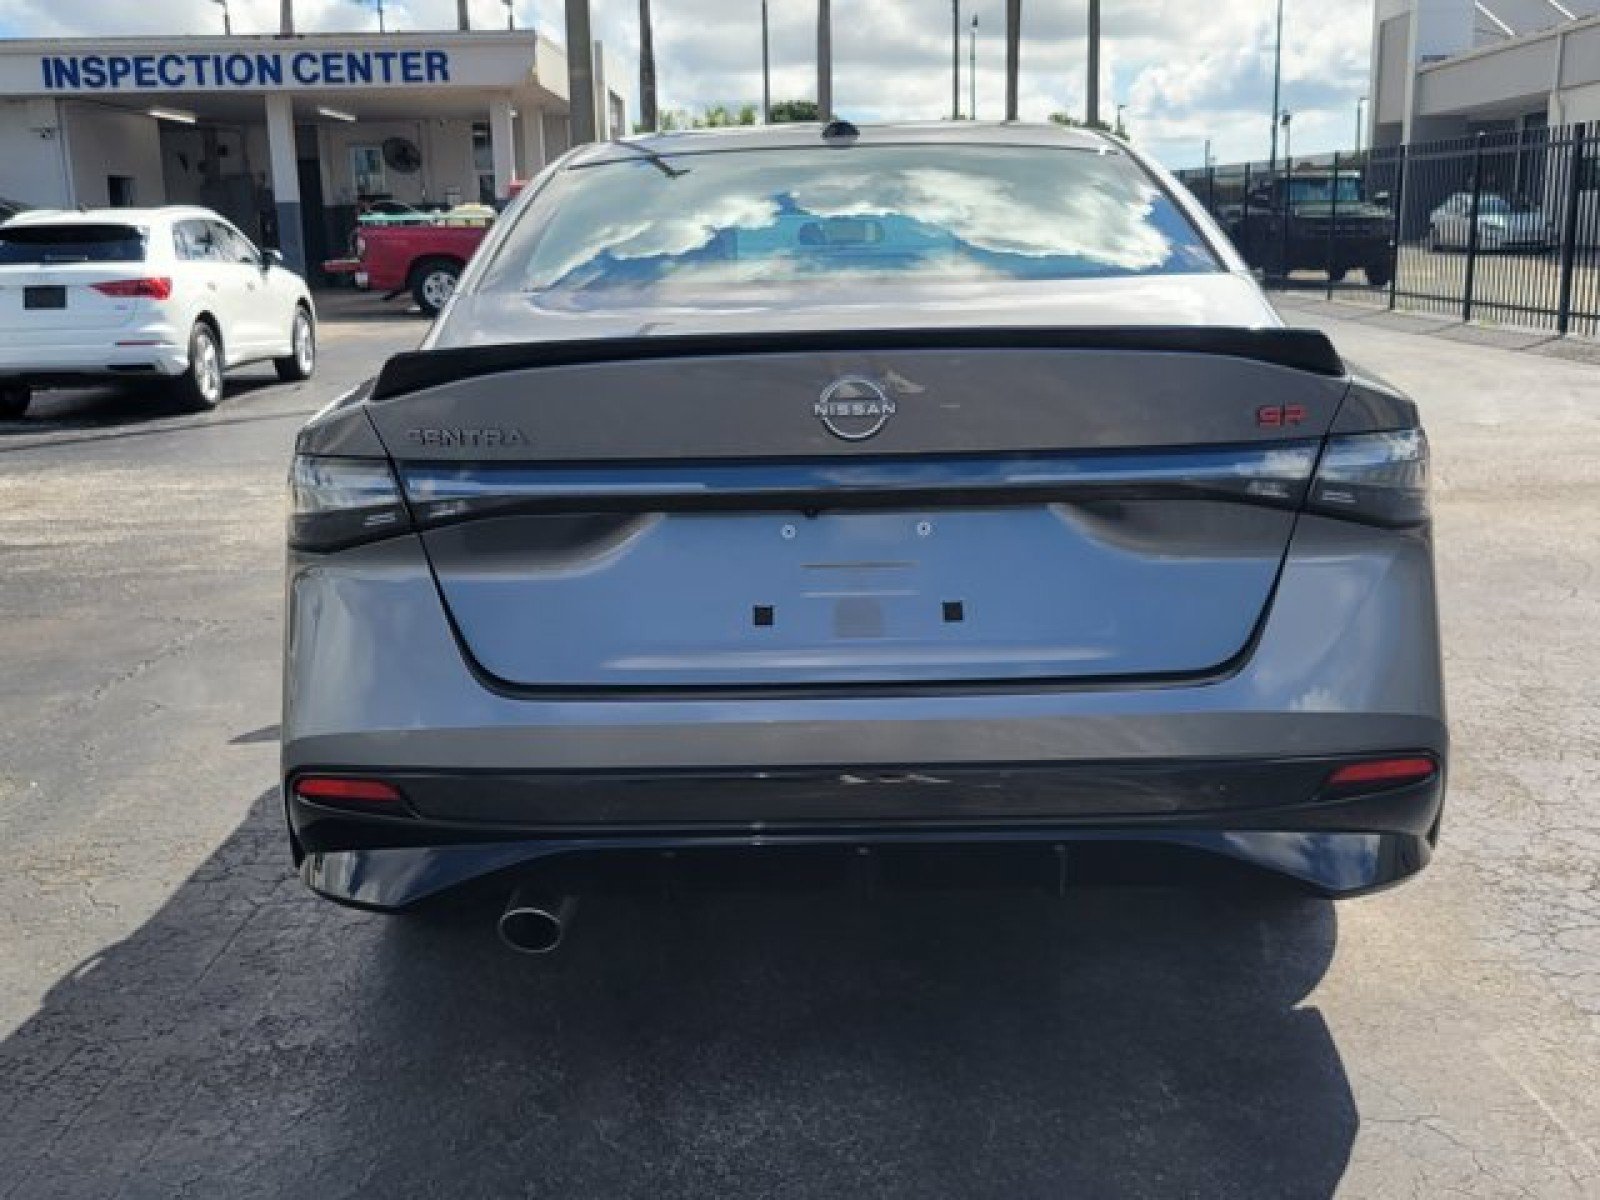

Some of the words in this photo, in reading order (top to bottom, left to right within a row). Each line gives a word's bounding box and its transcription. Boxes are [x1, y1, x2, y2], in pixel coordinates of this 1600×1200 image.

[41, 53, 283, 89] INSPECTION
[291, 50, 450, 86] CENTER
[813, 402, 896, 416] NISSAN
[1255, 405, 1306, 426] SR
[406, 428, 531, 447] SENTRA
